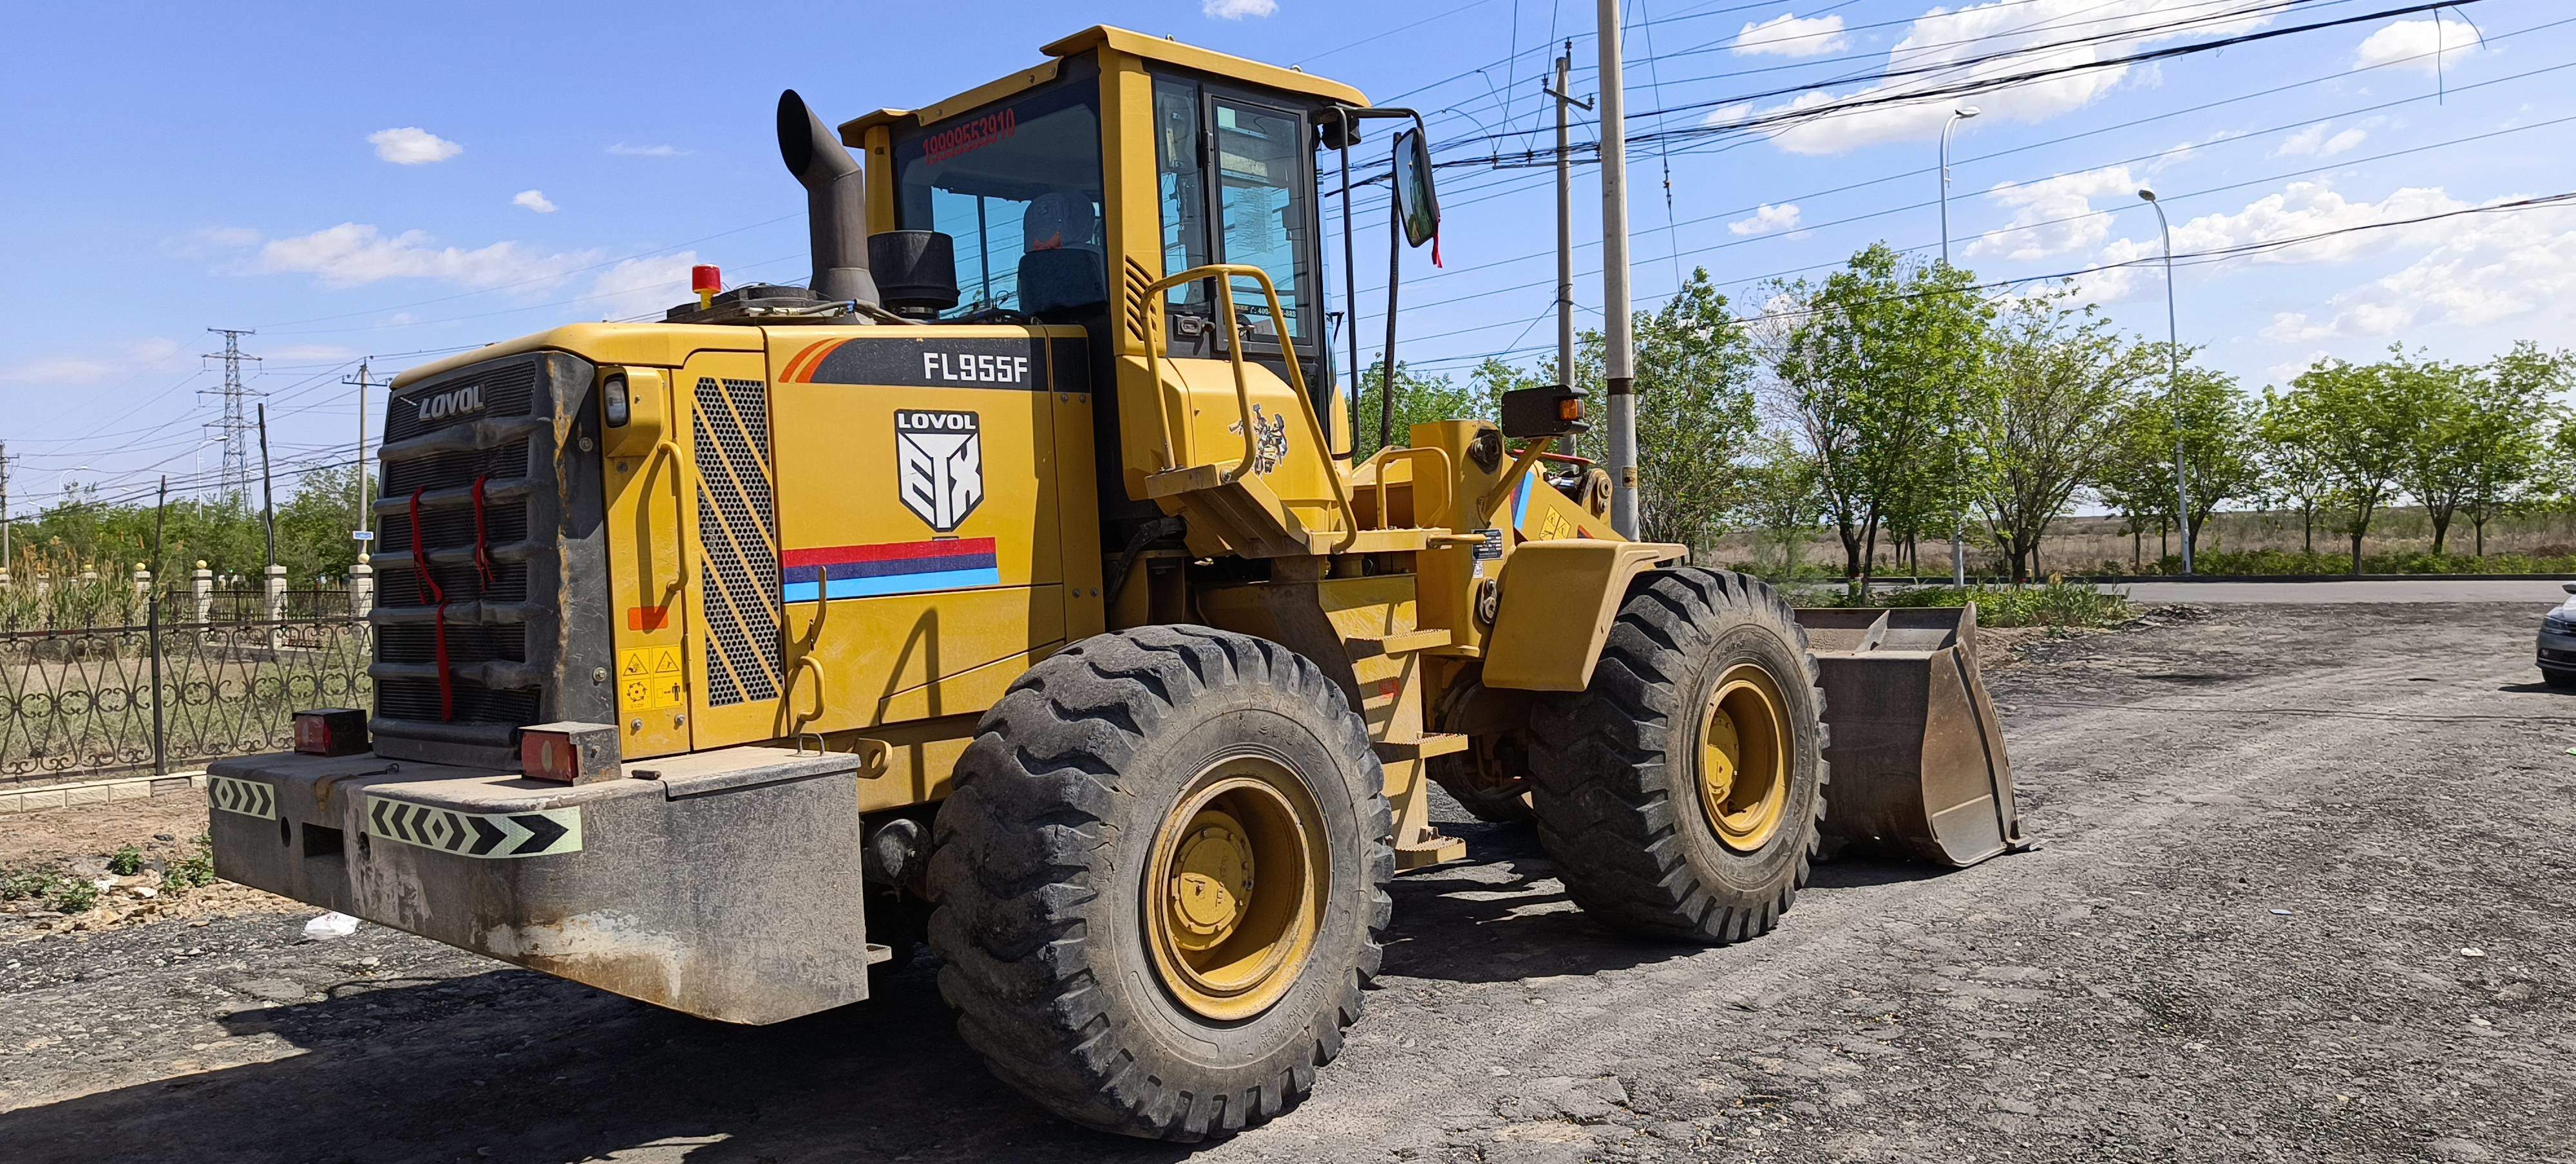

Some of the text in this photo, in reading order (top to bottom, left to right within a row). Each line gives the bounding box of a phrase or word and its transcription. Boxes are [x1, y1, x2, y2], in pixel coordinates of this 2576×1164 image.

[923, 352, 1028, 383] FL955F
[419, 385, 486, 421] LOVOL
[898, 413, 976, 430] LOVOL
